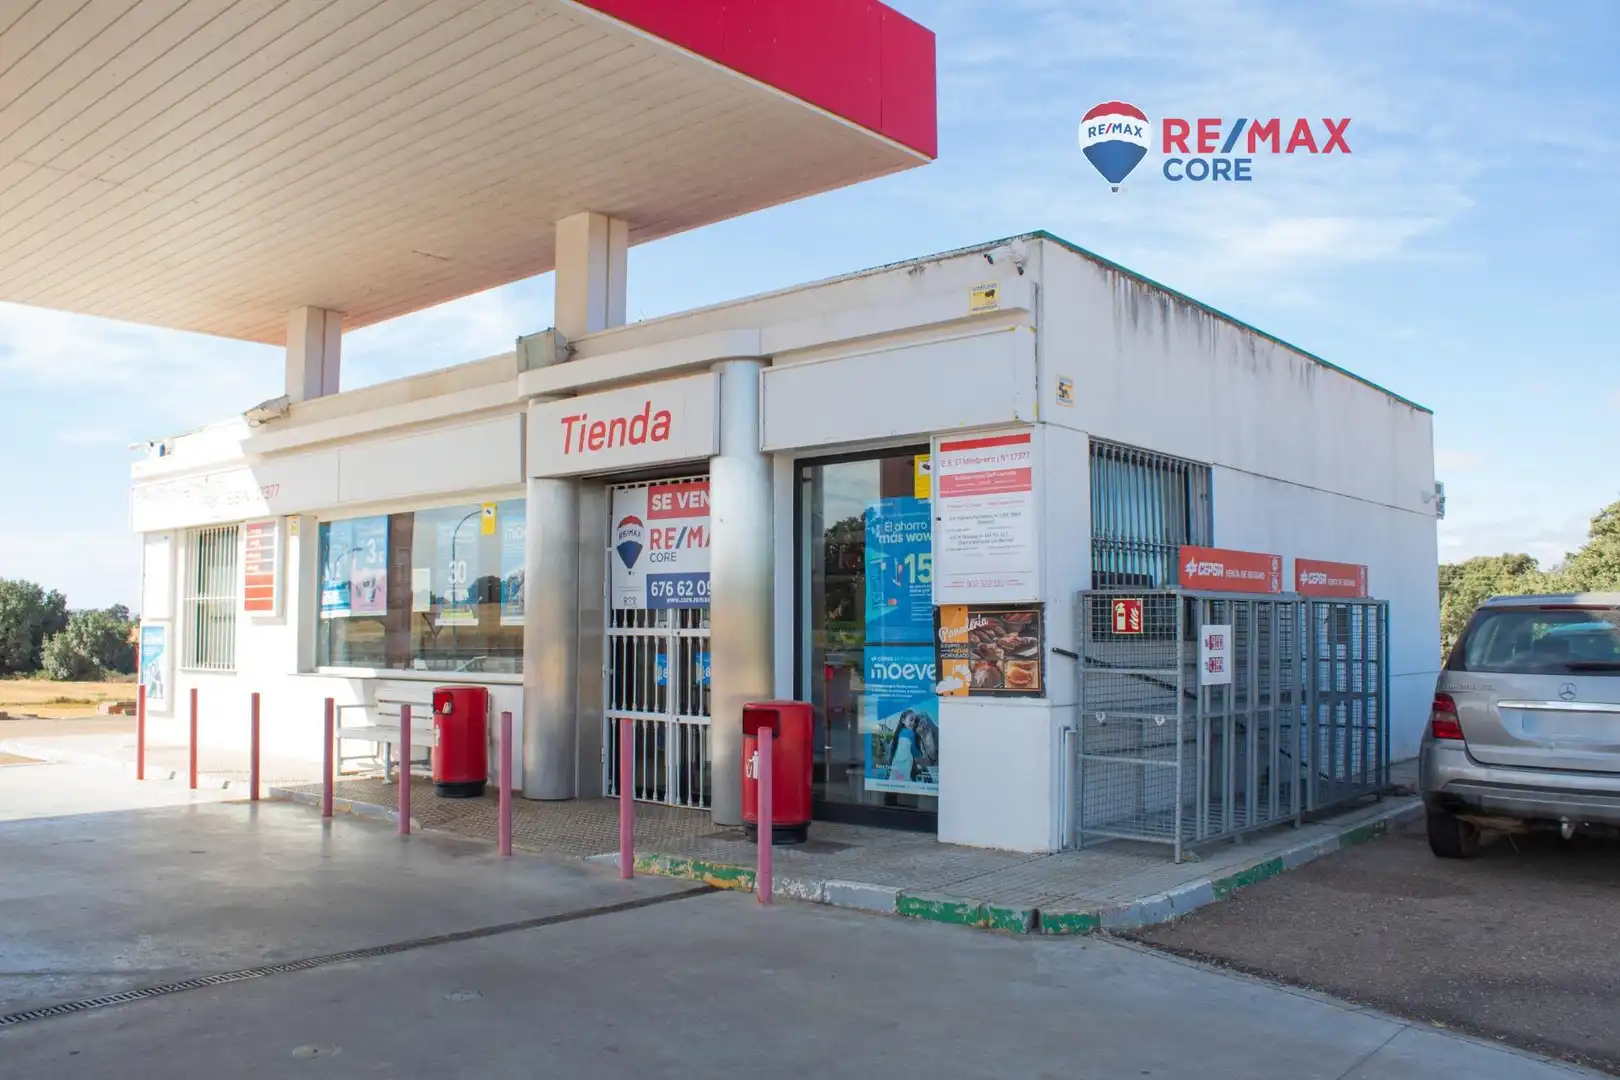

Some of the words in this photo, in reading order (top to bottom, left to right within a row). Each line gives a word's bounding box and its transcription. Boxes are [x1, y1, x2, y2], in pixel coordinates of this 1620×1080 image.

[560, 400, 672, 455] Tienda
[651, 493, 673, 511] SE
[618, 529, 641, 539] RE/MAX
[884, 521, 894, 532] El
[895, 521, 927, 532] ahorro
[879, 531, 903, 544] más
[649, 552, 677, 563] CORE
[1198, 562, 1224, 577] CEPSA
[1240, 571, 1247, 579] DE
[651, 581, 673, 597] 676
[677, 580, 694, 596] 62
[871, 663, 936, 680] moeve
